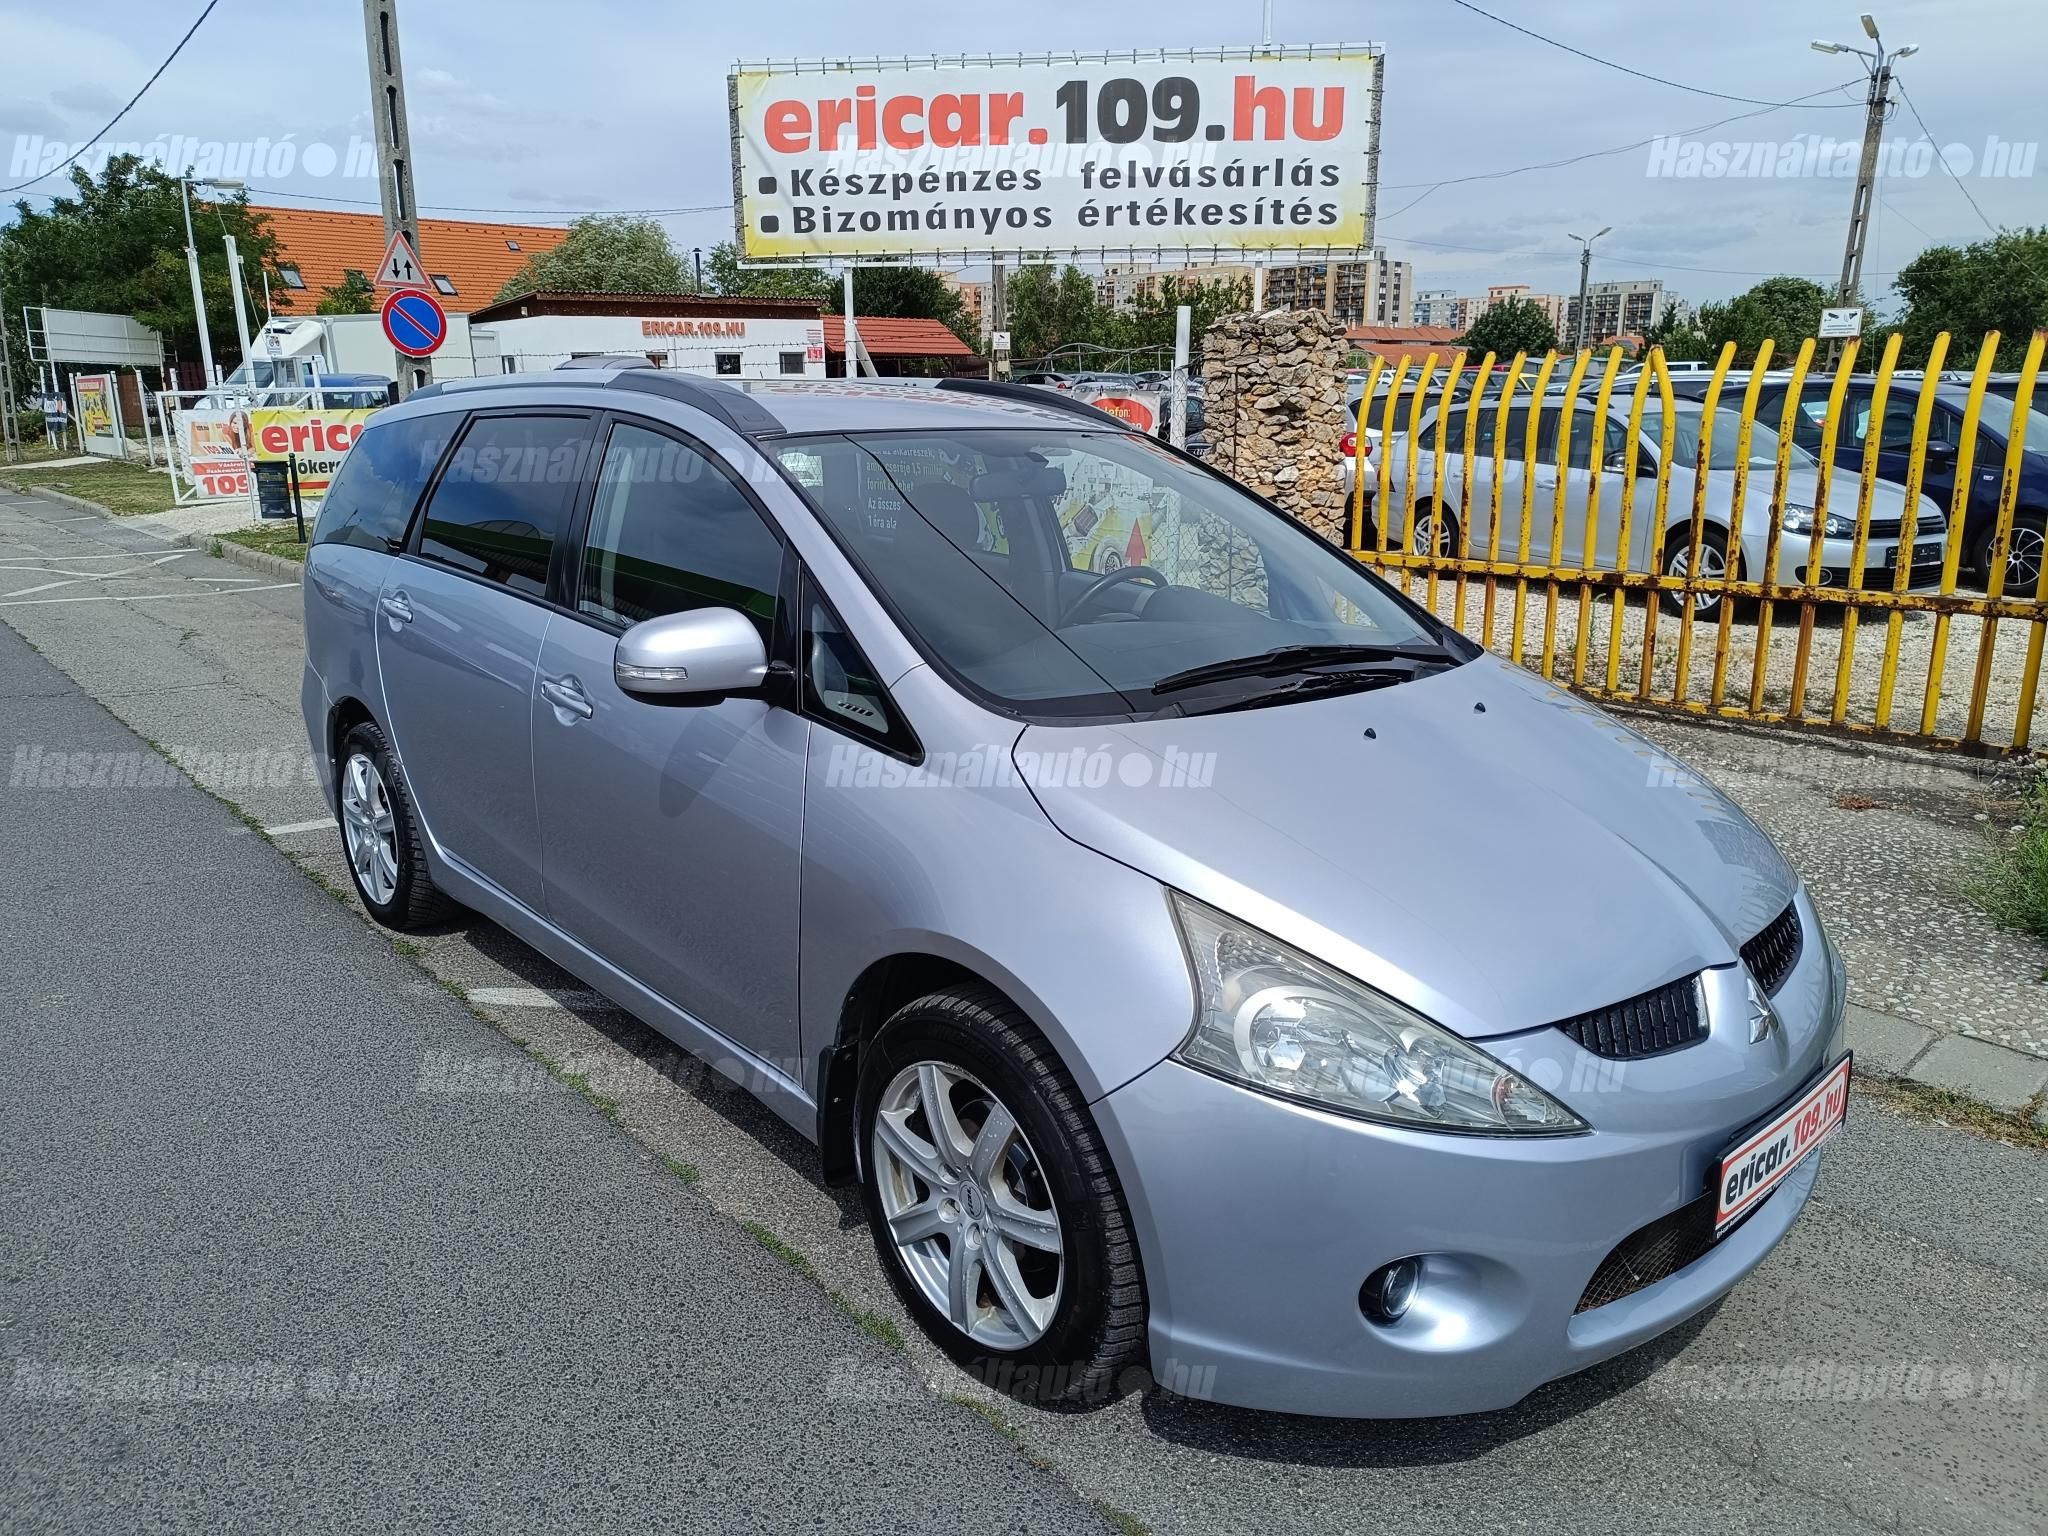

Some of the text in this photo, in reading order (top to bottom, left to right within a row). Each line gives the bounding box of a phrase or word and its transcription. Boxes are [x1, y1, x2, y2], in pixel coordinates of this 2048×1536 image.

[763, 75, 1346, 152] ericar.109.hu
[791, 157, 1341, 200] Készpénzes felvásárlás
[793, 197, 1339, 235] Bizományos értékesítés
[641, 320, 746, 337] ERICAR.109.HU
[1724, 1083, 1842, 1206] ericar.109.hu
